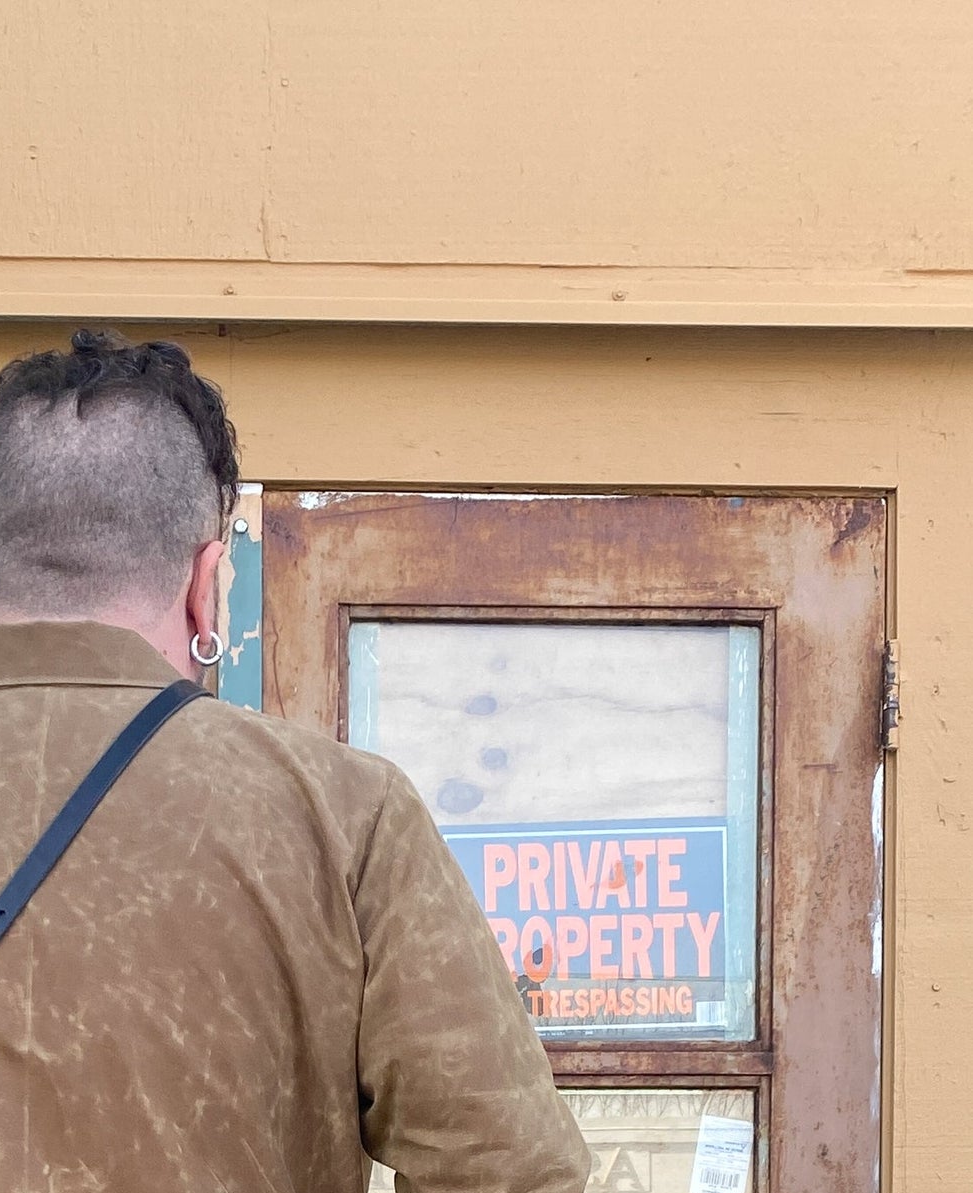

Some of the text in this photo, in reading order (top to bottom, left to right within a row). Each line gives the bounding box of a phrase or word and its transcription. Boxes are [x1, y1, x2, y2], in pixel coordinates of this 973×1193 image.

[484, 838, 688, 911] PRIVATE
[488, 912, 721, 982] ROPERTY
[527, 986, 693, 1018] TRESPASSING
